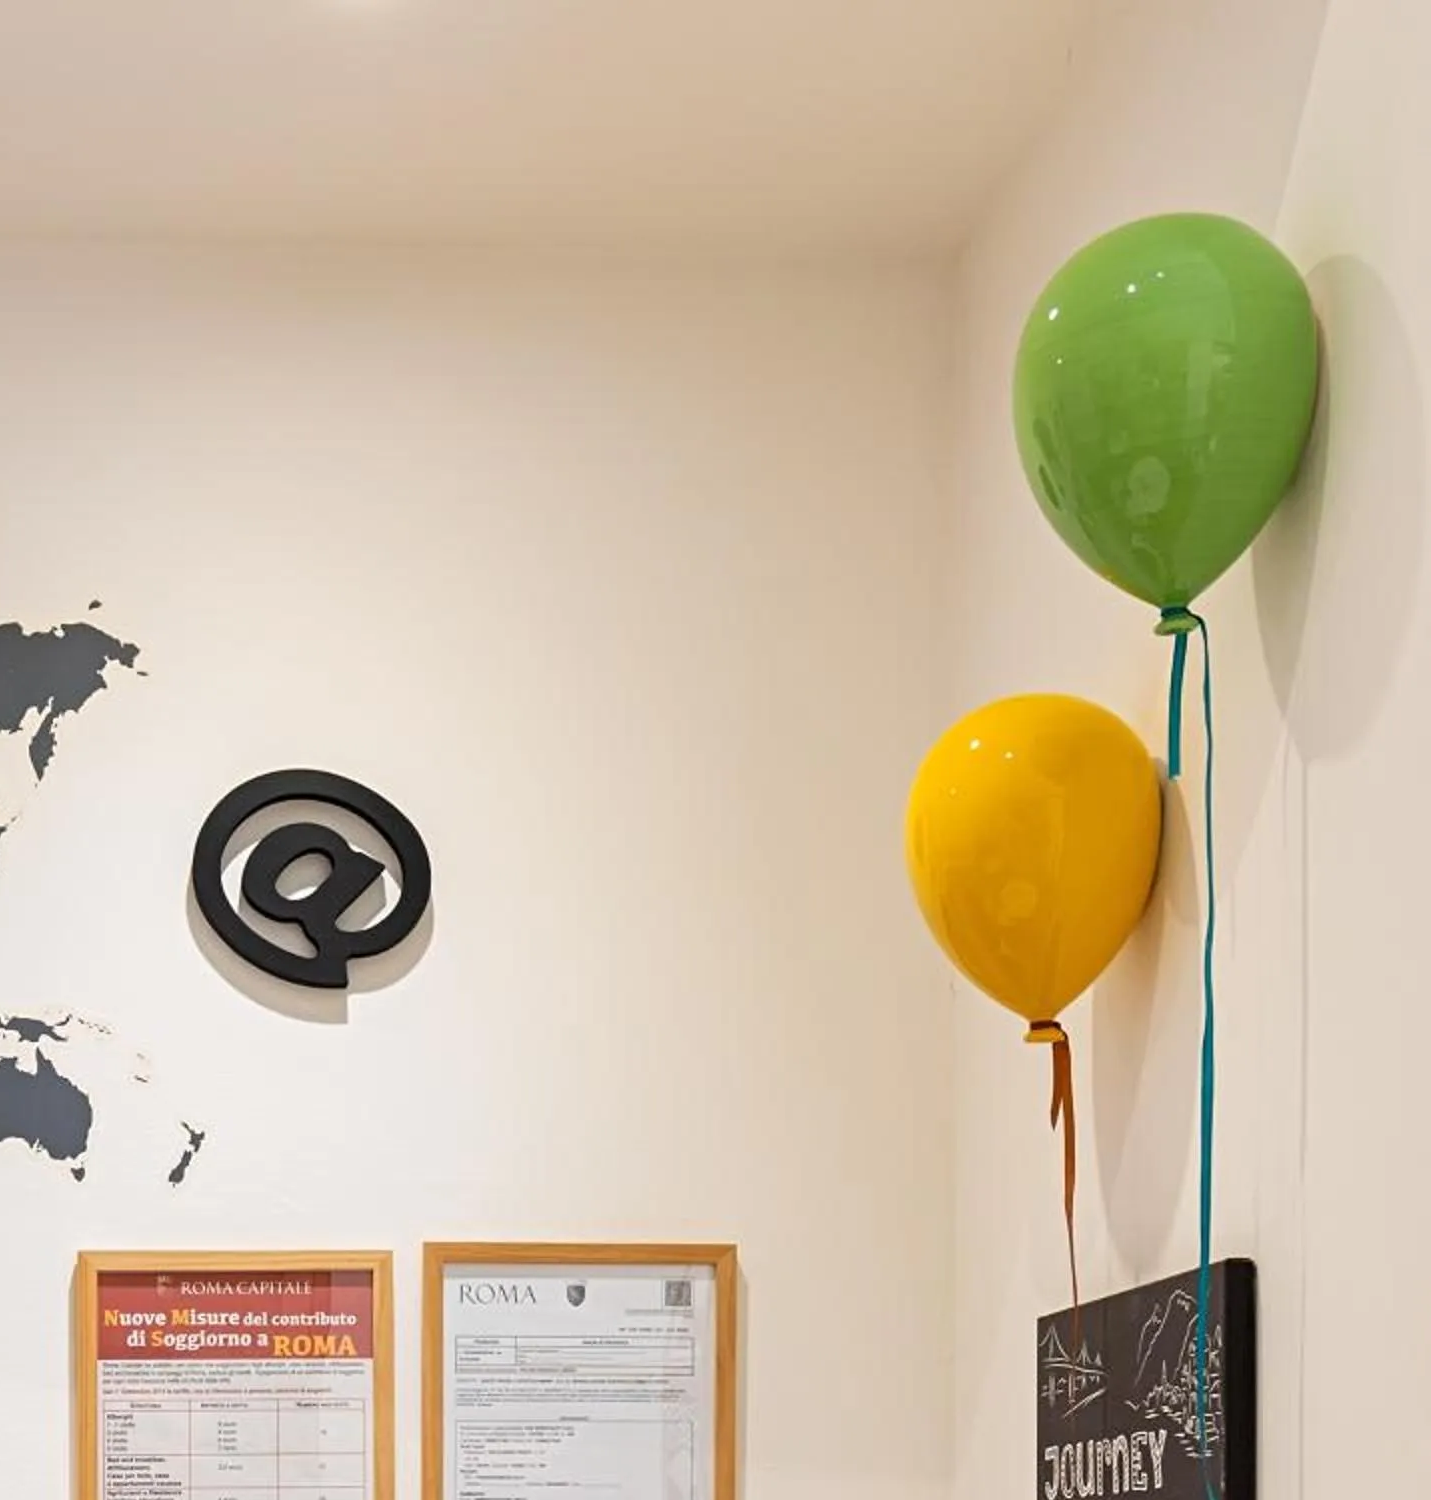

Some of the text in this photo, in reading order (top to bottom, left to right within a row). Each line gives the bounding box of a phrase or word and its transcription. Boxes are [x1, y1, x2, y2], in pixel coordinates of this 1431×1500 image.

[181, 1280, 313, 1295] ROMA CAPITALE
[459, 1283, 537, 1305] ROMA
[104, 1308, 357, 1326] Nuove Misure del contributo
[127, 1331, 358, 1357] di Soggiorno a ROMA
